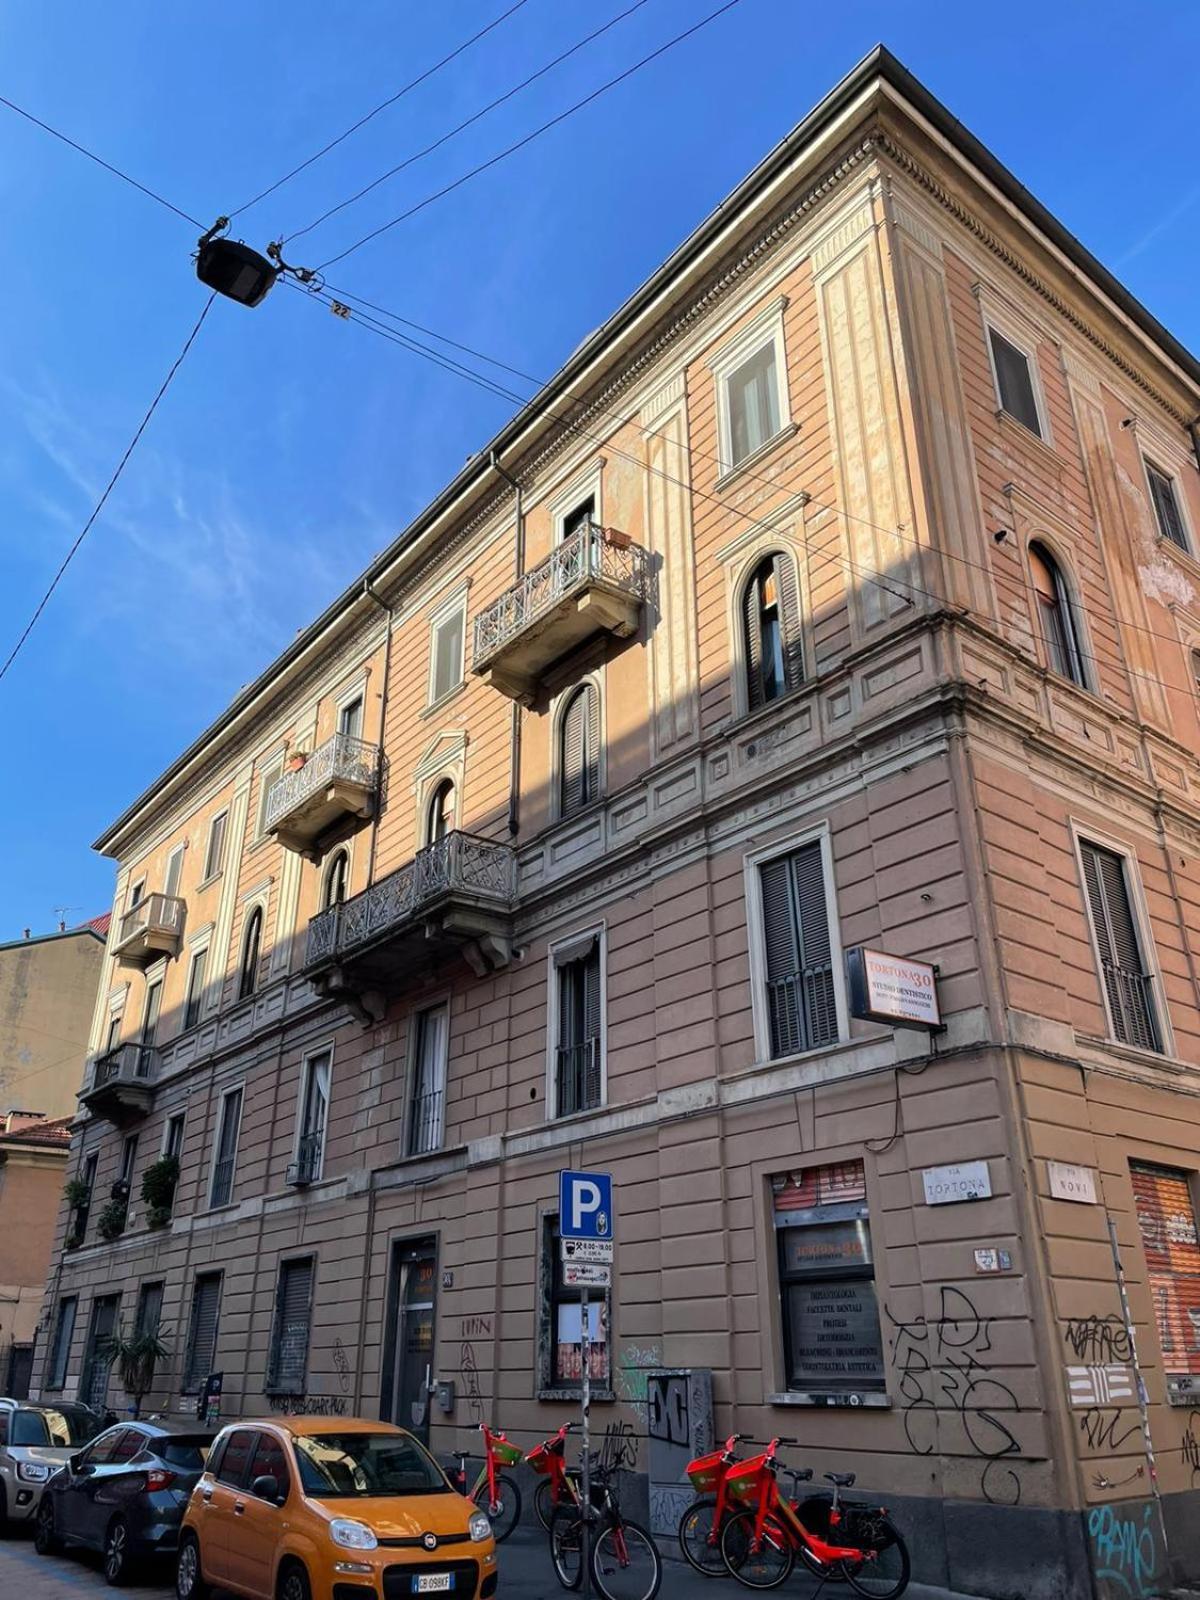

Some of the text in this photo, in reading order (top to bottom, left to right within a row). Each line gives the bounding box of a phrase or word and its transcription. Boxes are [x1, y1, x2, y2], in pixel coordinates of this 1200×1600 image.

[334, 304, 348, 318] 22
[928, 1178, 985, 1195] TORTONA
[1060, 1180, 1088, 1194] NOVI
[572, 1180, 602, 1229] P
